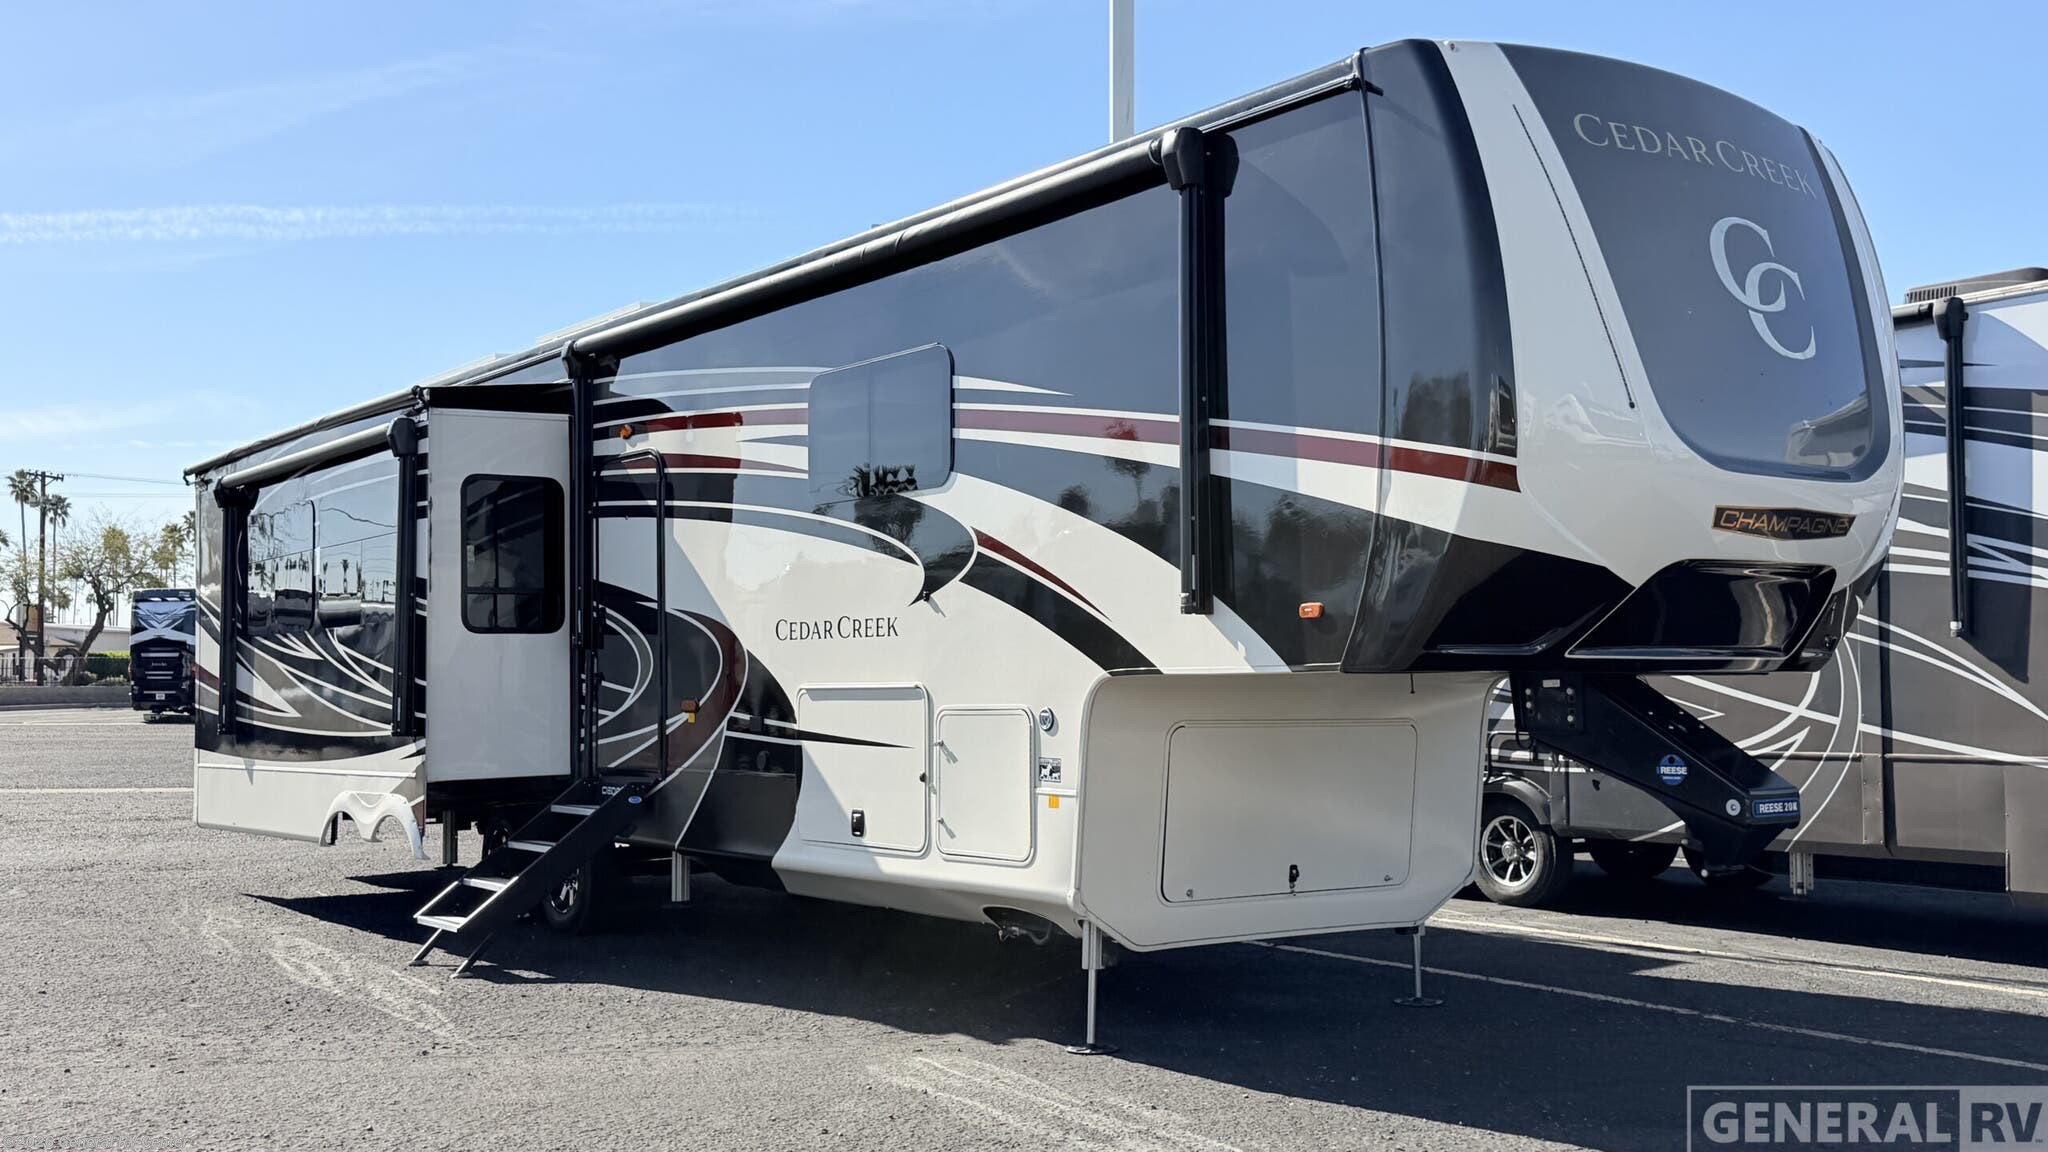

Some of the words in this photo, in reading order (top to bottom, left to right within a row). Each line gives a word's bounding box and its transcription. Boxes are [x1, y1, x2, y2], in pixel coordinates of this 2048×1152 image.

[1573, 113, 1714, 166] CEDAR
[1715, 140, 1817, 199] CREEK
[1720, 510, 1850, 534] CHAMPAGNE
[775, 618, 833, 641] CEDAR
[837, 615, 899, 639] CREEK
[1660, 766, 1687, 775] REESE
[1759, 803, 1784, 814] REESE
